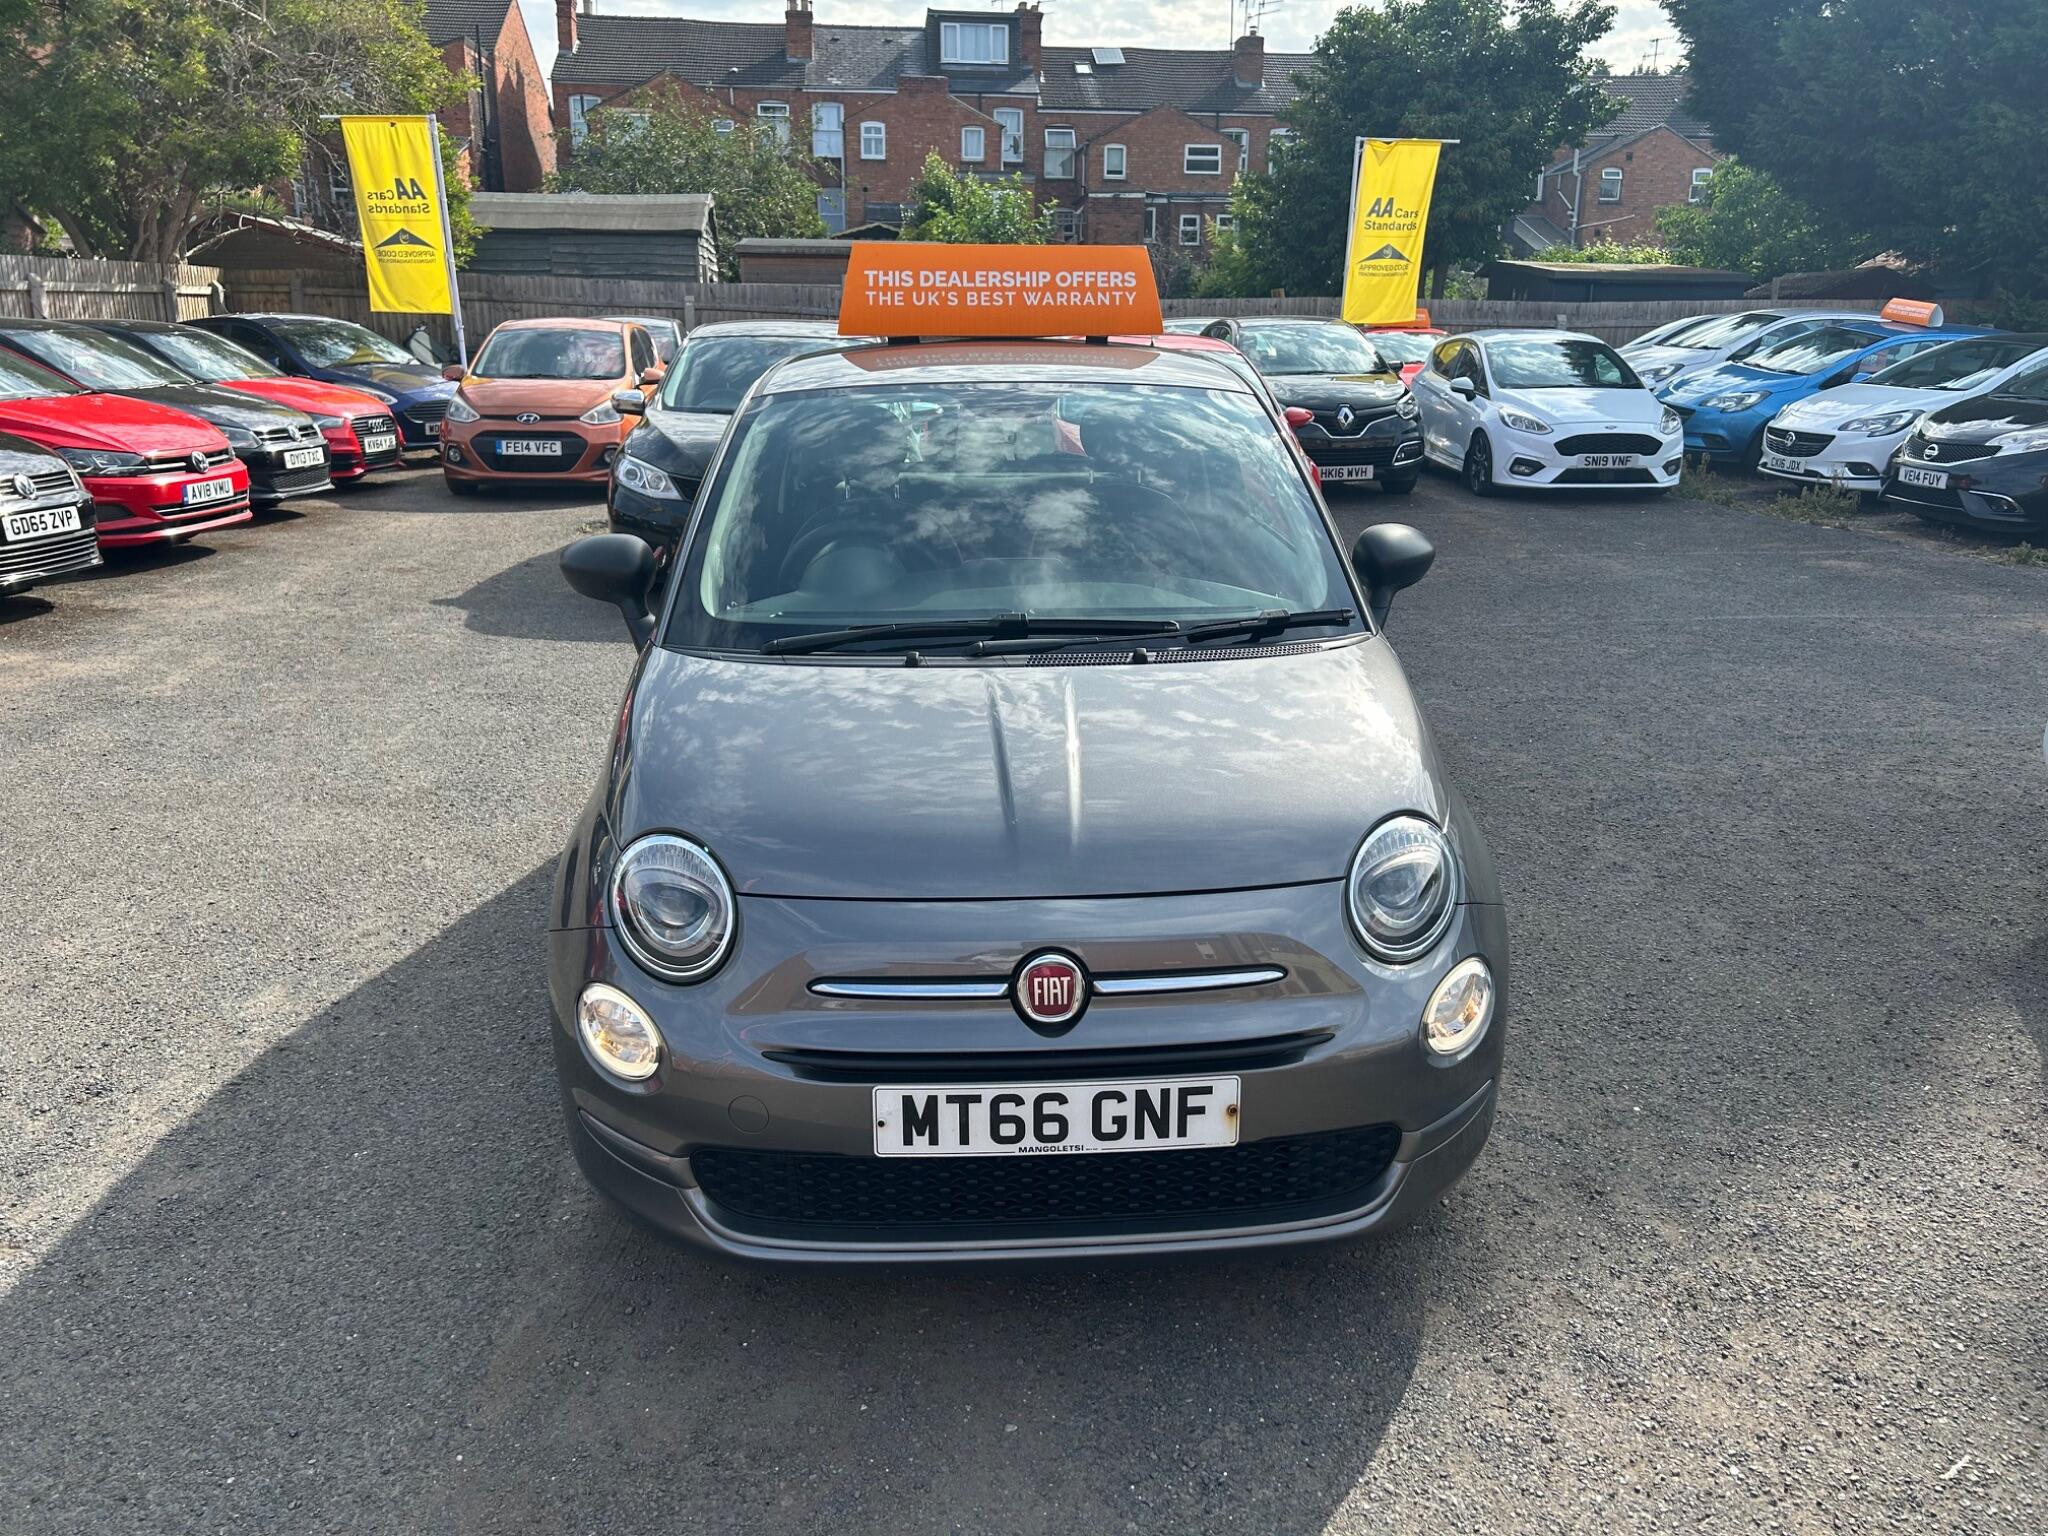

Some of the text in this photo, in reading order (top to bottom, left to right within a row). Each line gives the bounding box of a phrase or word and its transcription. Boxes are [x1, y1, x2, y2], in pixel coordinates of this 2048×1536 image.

[1367, 197, 1419, 218] AA Cars
[1364, 220, 1417, 231] Standards
[864, 270, 1137, 287] THIS DEALERSHIP OFFERS
[865, 291, 1137, 306] THE UK'S BEST WARRANTY
[505, 441, 557, 453] FE14 VFC
[1584, 456, 1632, 467] SN19 VNF
[1786, 460, 1801, 471] JDX
[1320, 467, 1368, 480] HK16 WVH
[1903, 468, 1942, 486] VE14 FUY
[191, 482, 230, 500] AV18 VMU
[10, 511, 73, 536] GD65 ZVP
[1033, 976, 1071, 1006] FIAT
[901, 1086, 1213, 1146] MT66 GNF
[1018, 1145, 1084, 1153] MANGOLETSI
